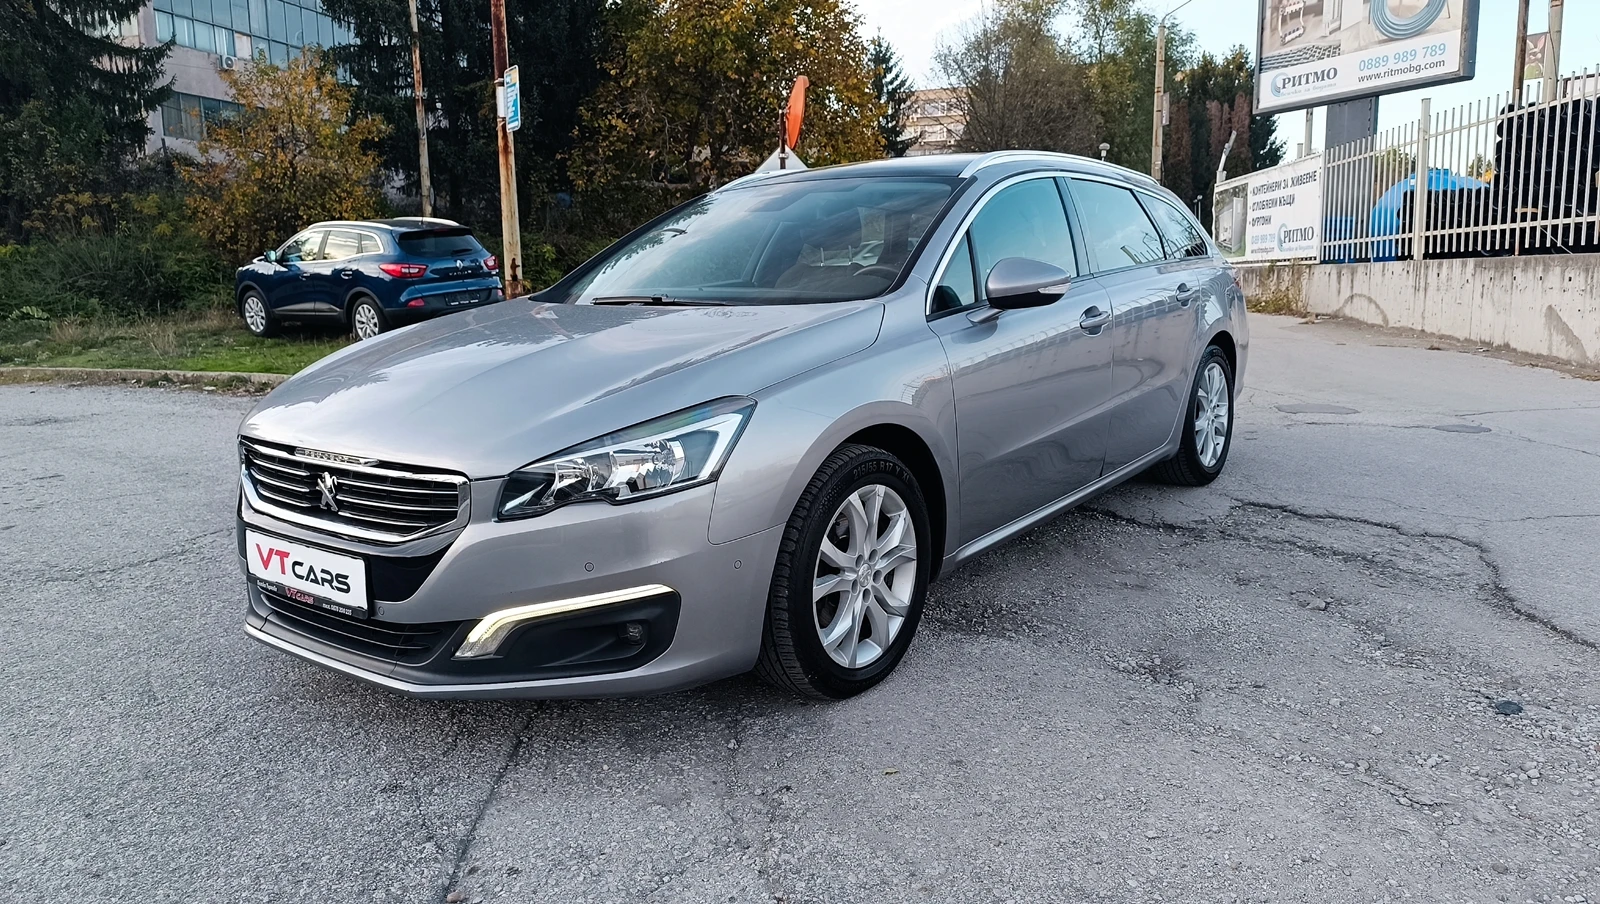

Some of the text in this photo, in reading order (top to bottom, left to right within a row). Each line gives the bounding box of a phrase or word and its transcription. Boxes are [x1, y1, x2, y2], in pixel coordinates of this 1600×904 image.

[1359, 43, 1446, 71] 0889 989 789
[1281, 67, 1338, 90] РИТМО
[1358, 59, 1446, 82] www.ritmobg.com
[1282, 178, 1289, 190] ЗА
[1283, 226, 1315, 243] РИТМО
[255, 543, 351, 594] VT CARS
